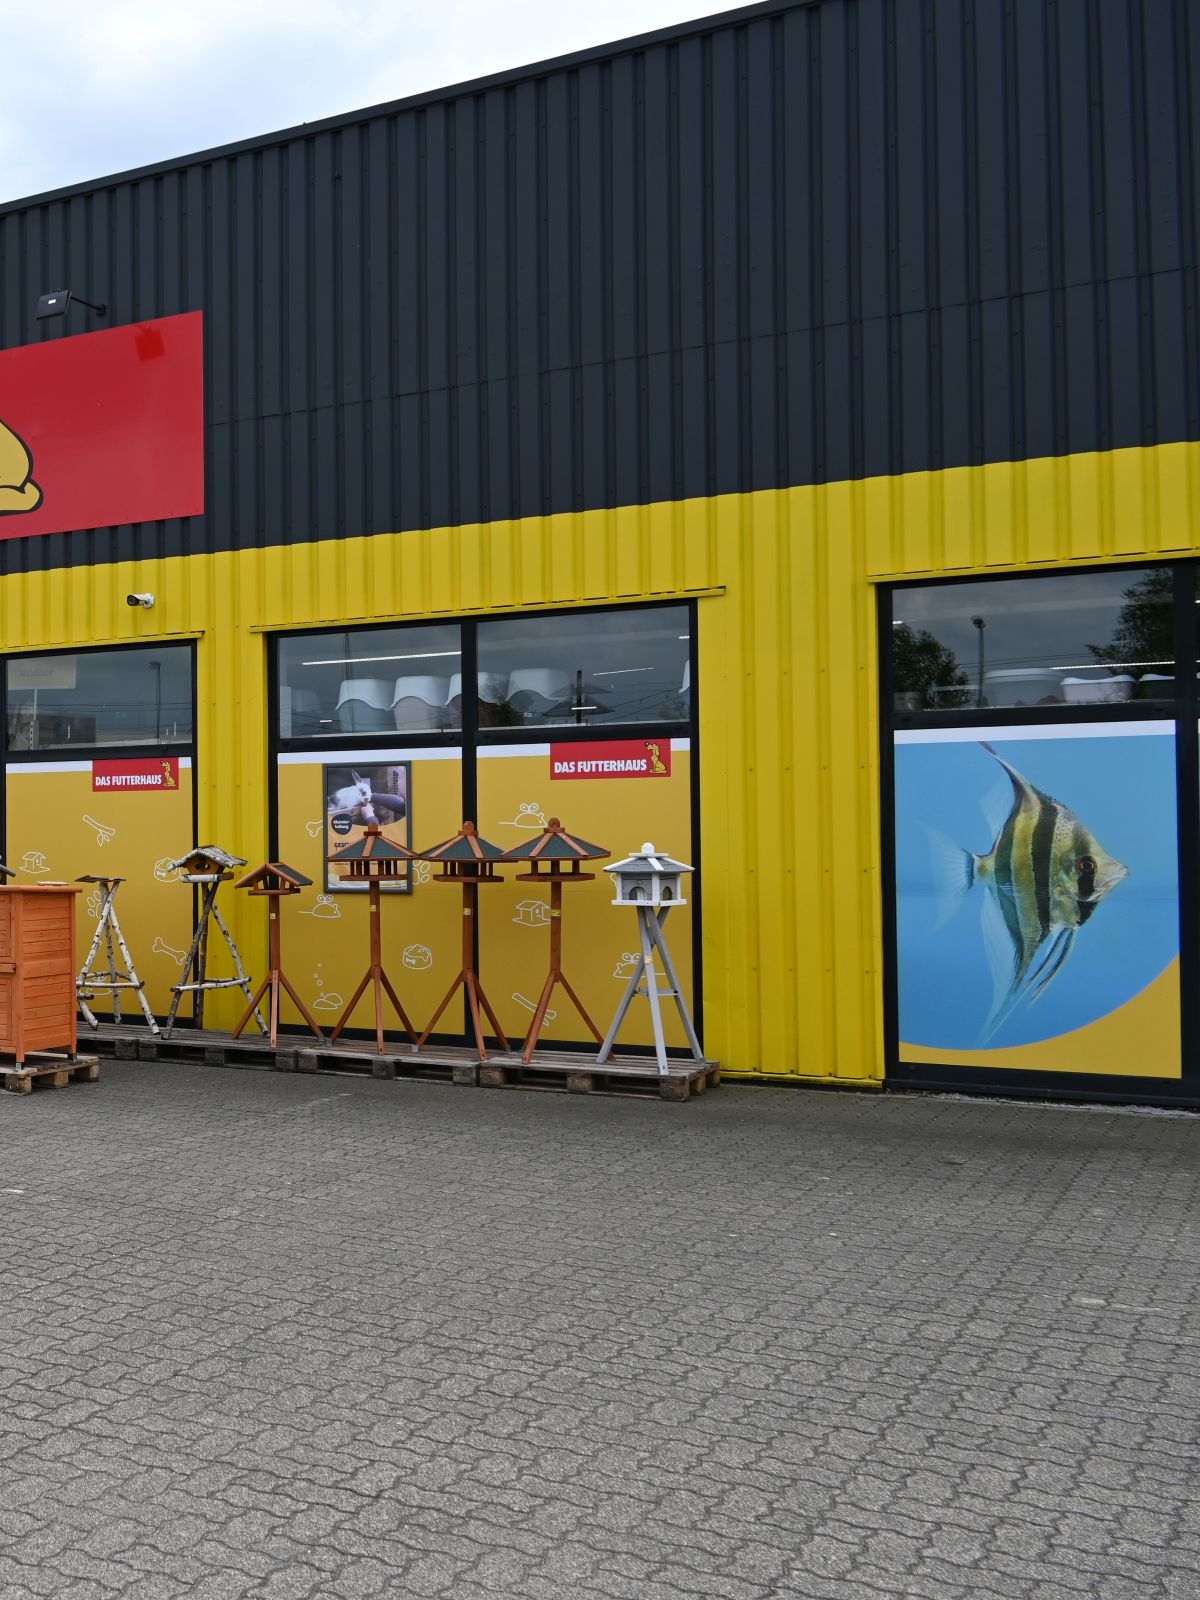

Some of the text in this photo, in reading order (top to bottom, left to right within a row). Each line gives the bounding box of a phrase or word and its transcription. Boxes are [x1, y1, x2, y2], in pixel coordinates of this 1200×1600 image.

[554, 759, 647, 774] DAS FUTTERHAUS
[95, 774, 162, 786] DAS FUTTERHAUS
